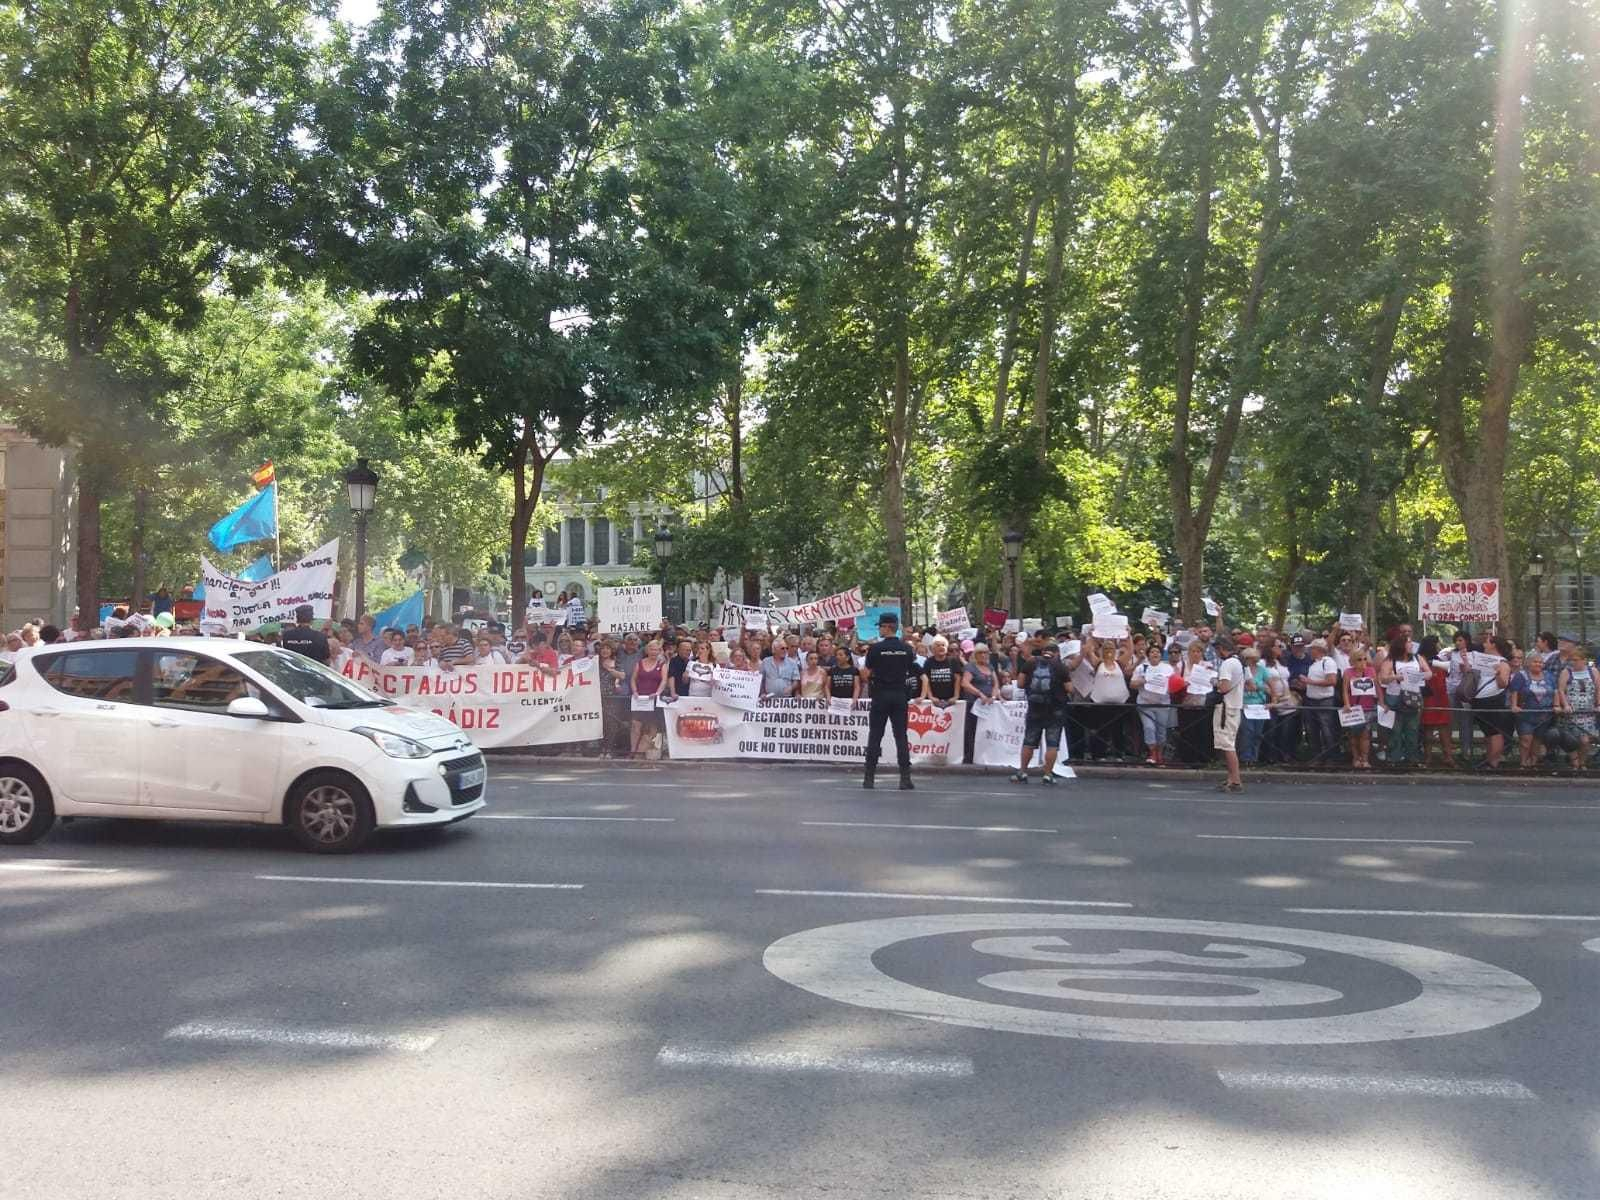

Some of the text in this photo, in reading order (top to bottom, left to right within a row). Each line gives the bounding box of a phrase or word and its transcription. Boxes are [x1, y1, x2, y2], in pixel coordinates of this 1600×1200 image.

[613, 587, 652, 596] SANIDAD
[793, 587, 864, 622] MENTIRAS
[611, 622, 652, 632] MASACRE
[431, 702, 500, 729] ÁDIZ
[743, 711, 802, 724] AFECTADOS
[805, 713, 827, 725] POR
[843, 715, 869, 727] ESTA
[764, 727, 858, 741] DE LOS DENTISTAS
[739, 740, 759, 752] QUE
[761, 742, 776, 753] NO
[778, 742, 830, 755] TUVIERON
